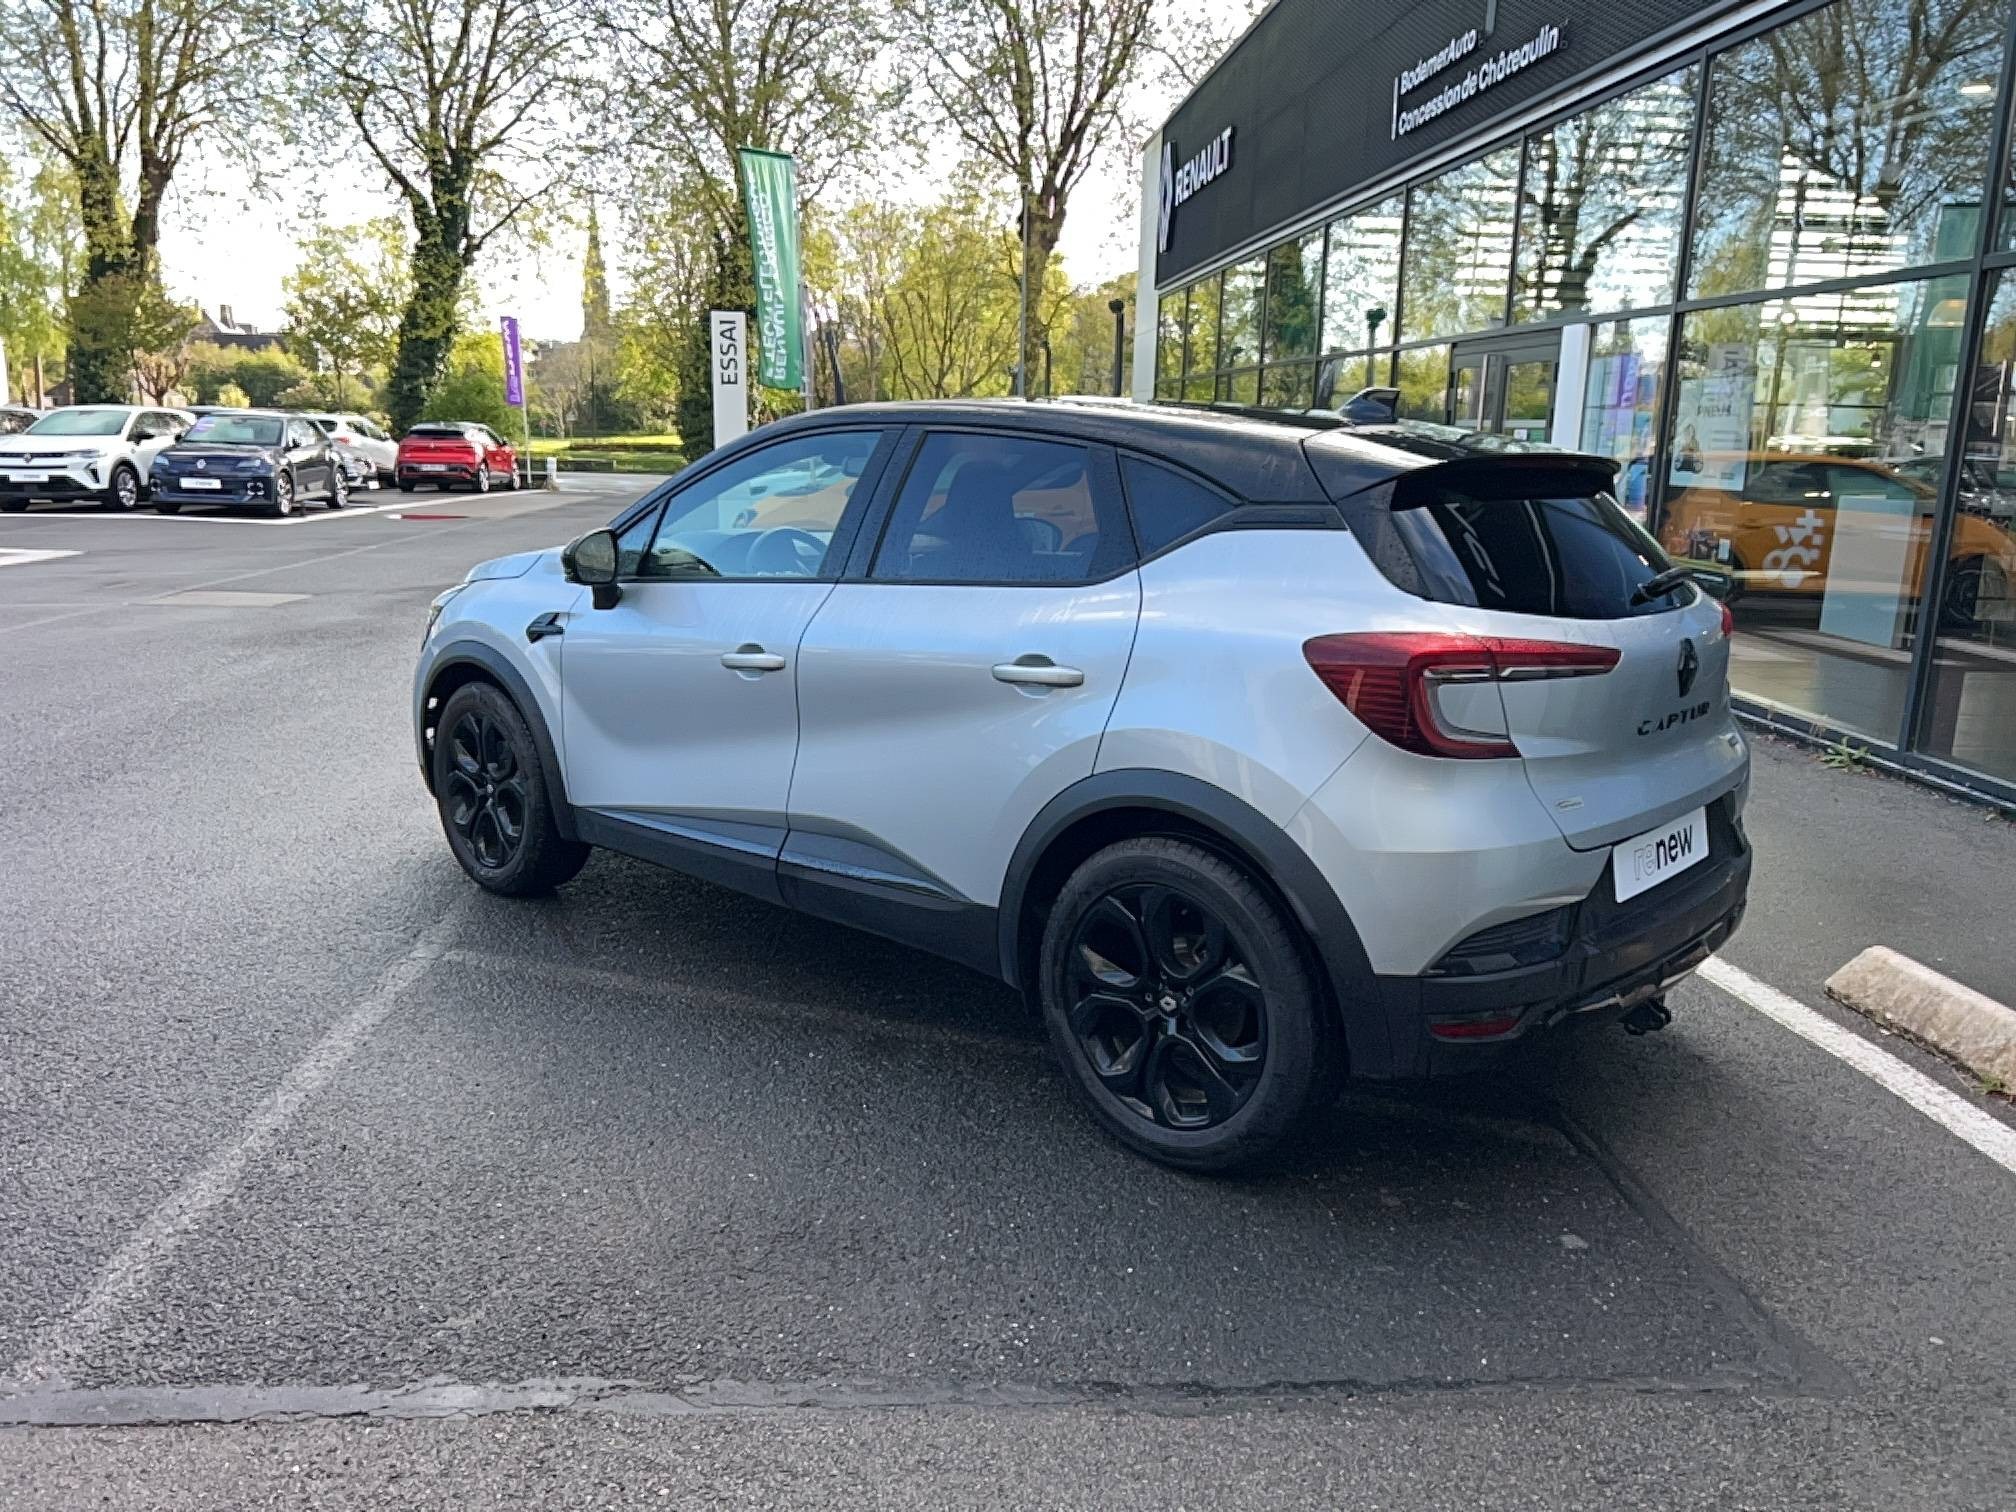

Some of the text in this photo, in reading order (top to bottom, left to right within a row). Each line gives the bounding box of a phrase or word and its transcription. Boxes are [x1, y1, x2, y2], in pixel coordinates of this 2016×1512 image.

[1399, 85, 1461, 135] Concession
[1461, 70, 1478, 100] de
[1175, 125, 1232, 207] RENAULT
[719, 319, 738, 385] ESSAI
[1633, 823, 1692, 881] renew
